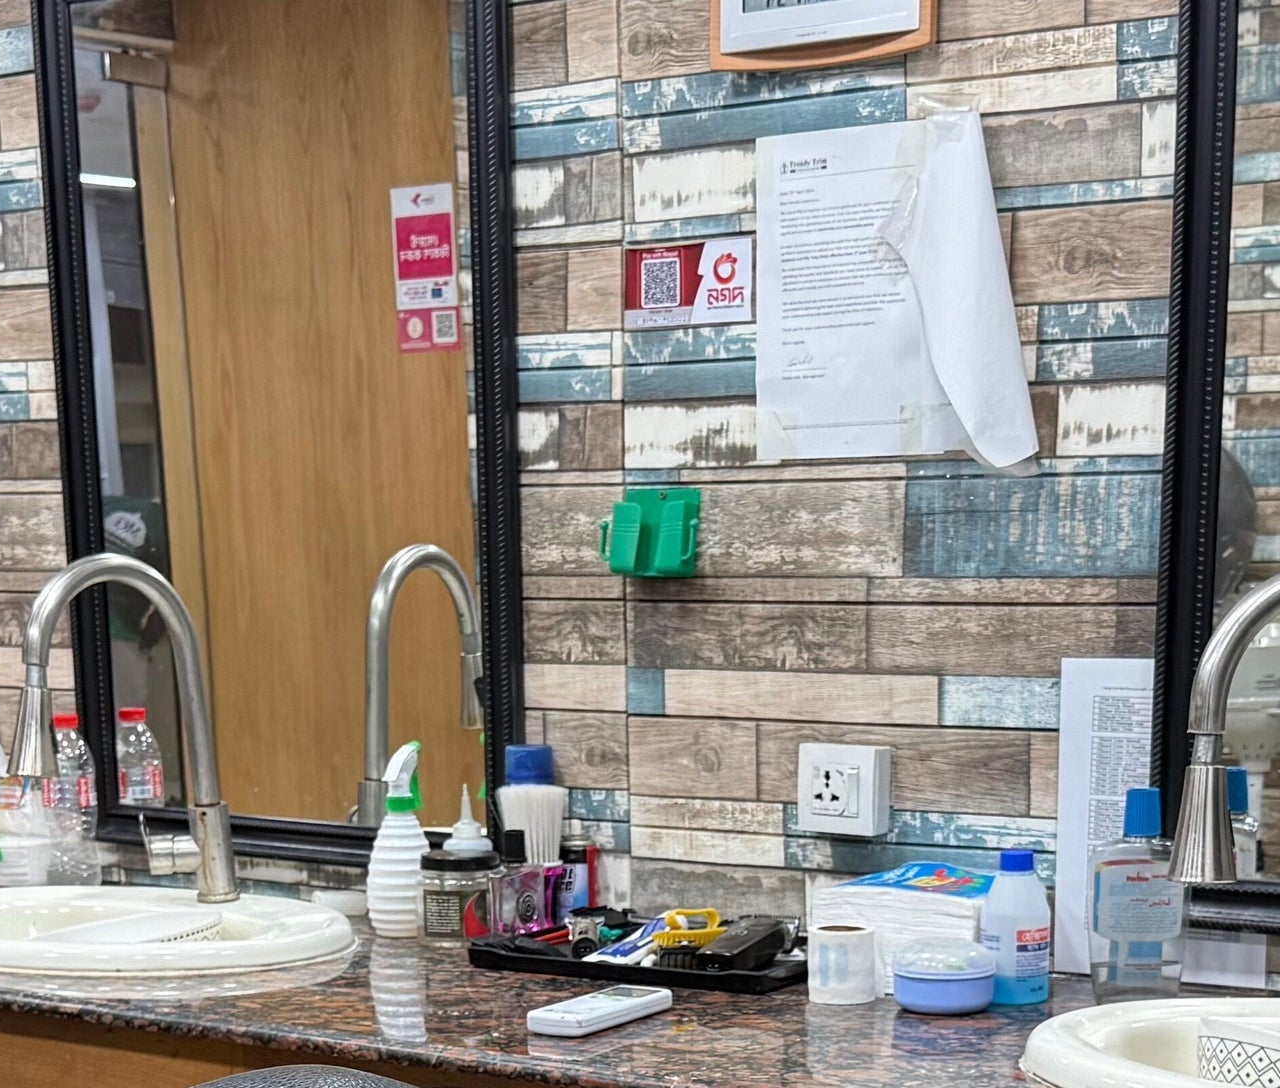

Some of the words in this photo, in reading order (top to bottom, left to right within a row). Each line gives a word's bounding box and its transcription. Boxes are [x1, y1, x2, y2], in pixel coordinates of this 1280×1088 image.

[789, 160, 810, 170] Trendy
[812, 158, 828, 166] Trim
[707, 286, 744, 305] নগদ
